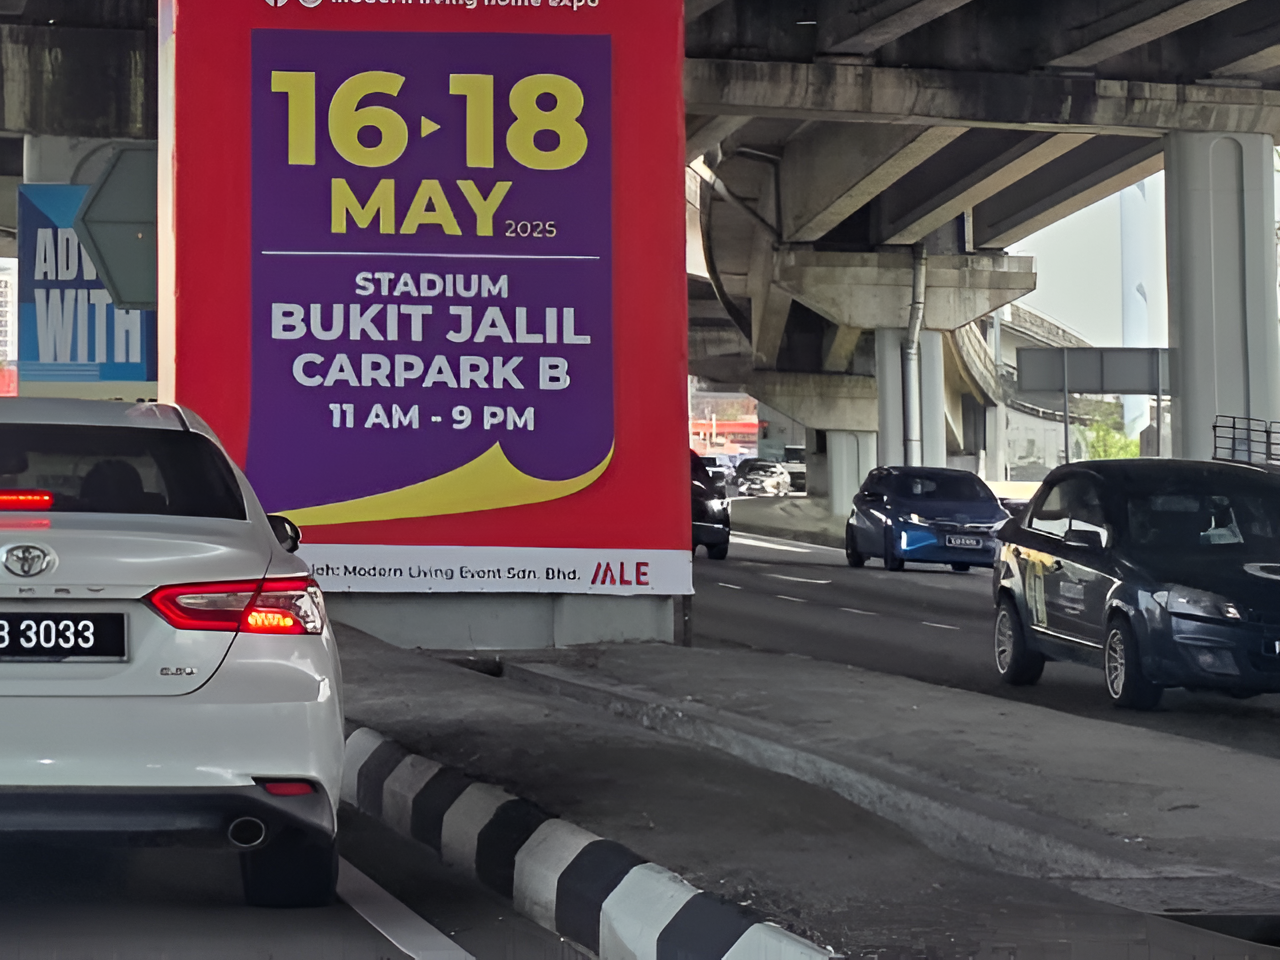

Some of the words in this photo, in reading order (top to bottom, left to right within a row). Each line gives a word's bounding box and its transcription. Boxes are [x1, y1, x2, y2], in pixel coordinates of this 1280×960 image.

[271, 70, 409, 168] 16
[449, 73, 588, 171] 18
[331, 177, 513, 237] MAY
[504, 220, 558, 238] 2025
[355, 271, 509, 299] STADIUM
[33, 288, 142, 363] WITH
[271, 302, 433, 342] BUKIT
[445, 304, 592, 345] JALIL
[292, 353, 525, 390] CARPARK
[538, 356, 572, 391] B
[328, 403, 355, 429] 11
[364, 403, 420, 430] AM
[451, 405, 473, 430] 9
[483, 406, 536, 431] PM
[342, 564, 404, 578] Modern
[19, 620, 95, 649] 3033
